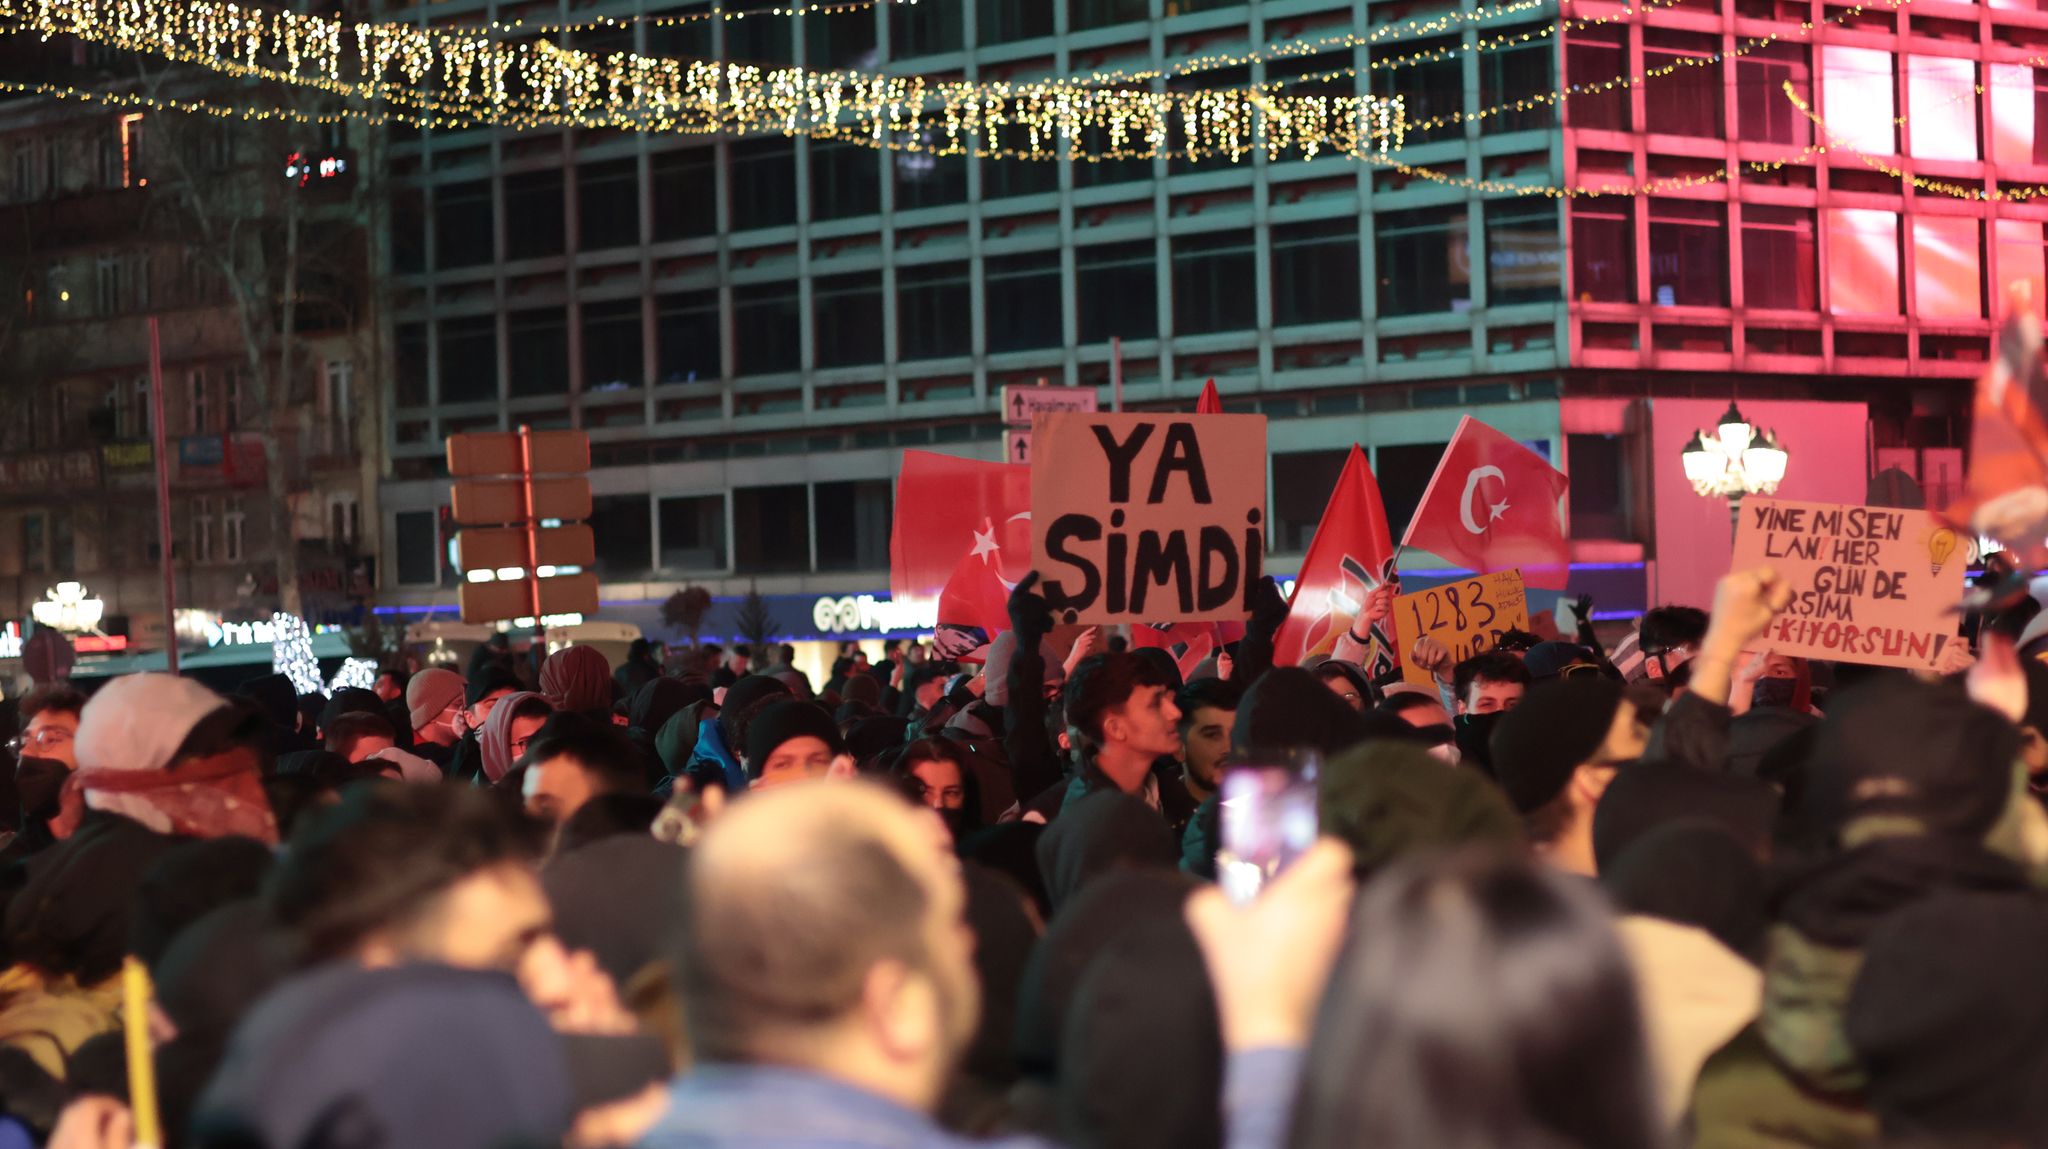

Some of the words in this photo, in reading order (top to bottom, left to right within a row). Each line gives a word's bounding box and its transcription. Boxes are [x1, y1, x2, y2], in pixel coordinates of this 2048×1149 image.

[1090, 422, 1213, 505] YA
[1041, 507, 1263, 625] ŞİMDİ
[1832, 538, 1880, 567] HER
[1411, 581, 1496, 639] 1283
[1872, 569, 1908, 600] DE
